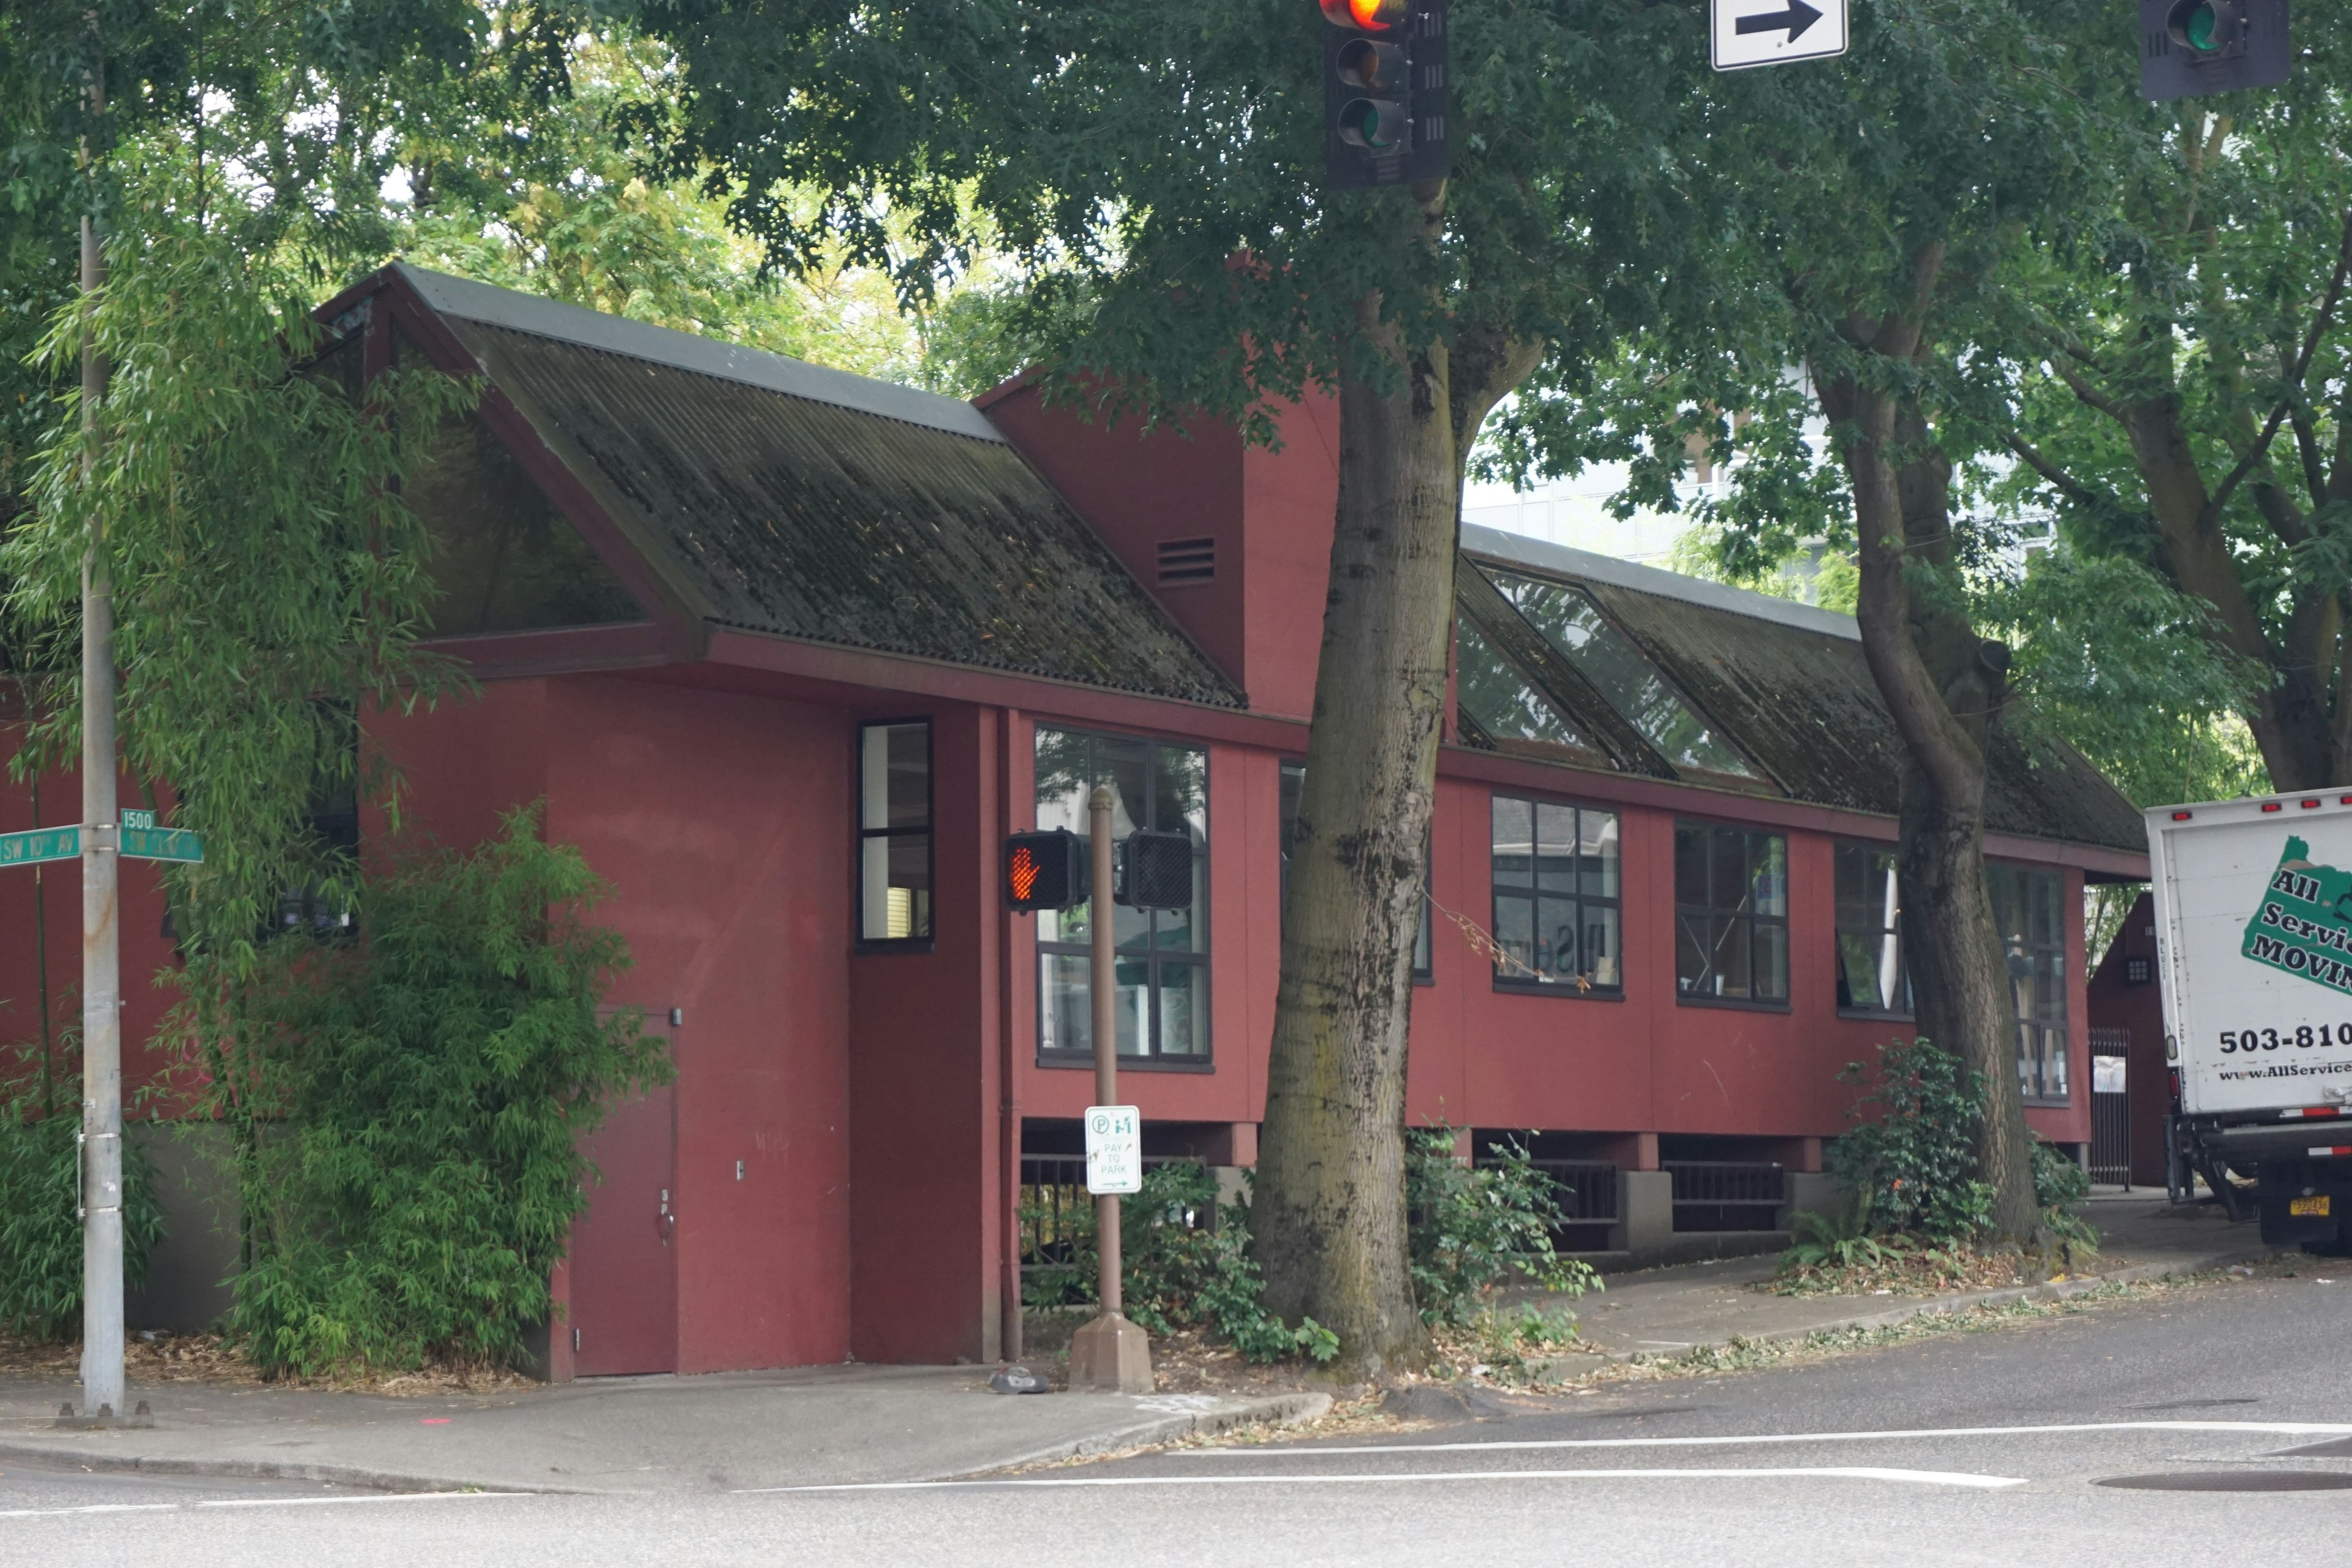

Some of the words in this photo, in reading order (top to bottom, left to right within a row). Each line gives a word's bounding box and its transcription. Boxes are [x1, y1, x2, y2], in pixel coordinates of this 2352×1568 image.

[124, 812, 152, 829] 1500
[4, 837, 23, 861] SW
[57, 832, 74, 854] AV
[2271, 868, 2321, 903] All
[2220, 1022, 2352, 1054] 503-810
[1104, 1144, 1122, 1152] PAY
[1107, 1154, 1120, 1163] TO
[1101, 1164, 1128, 1174] PARK
